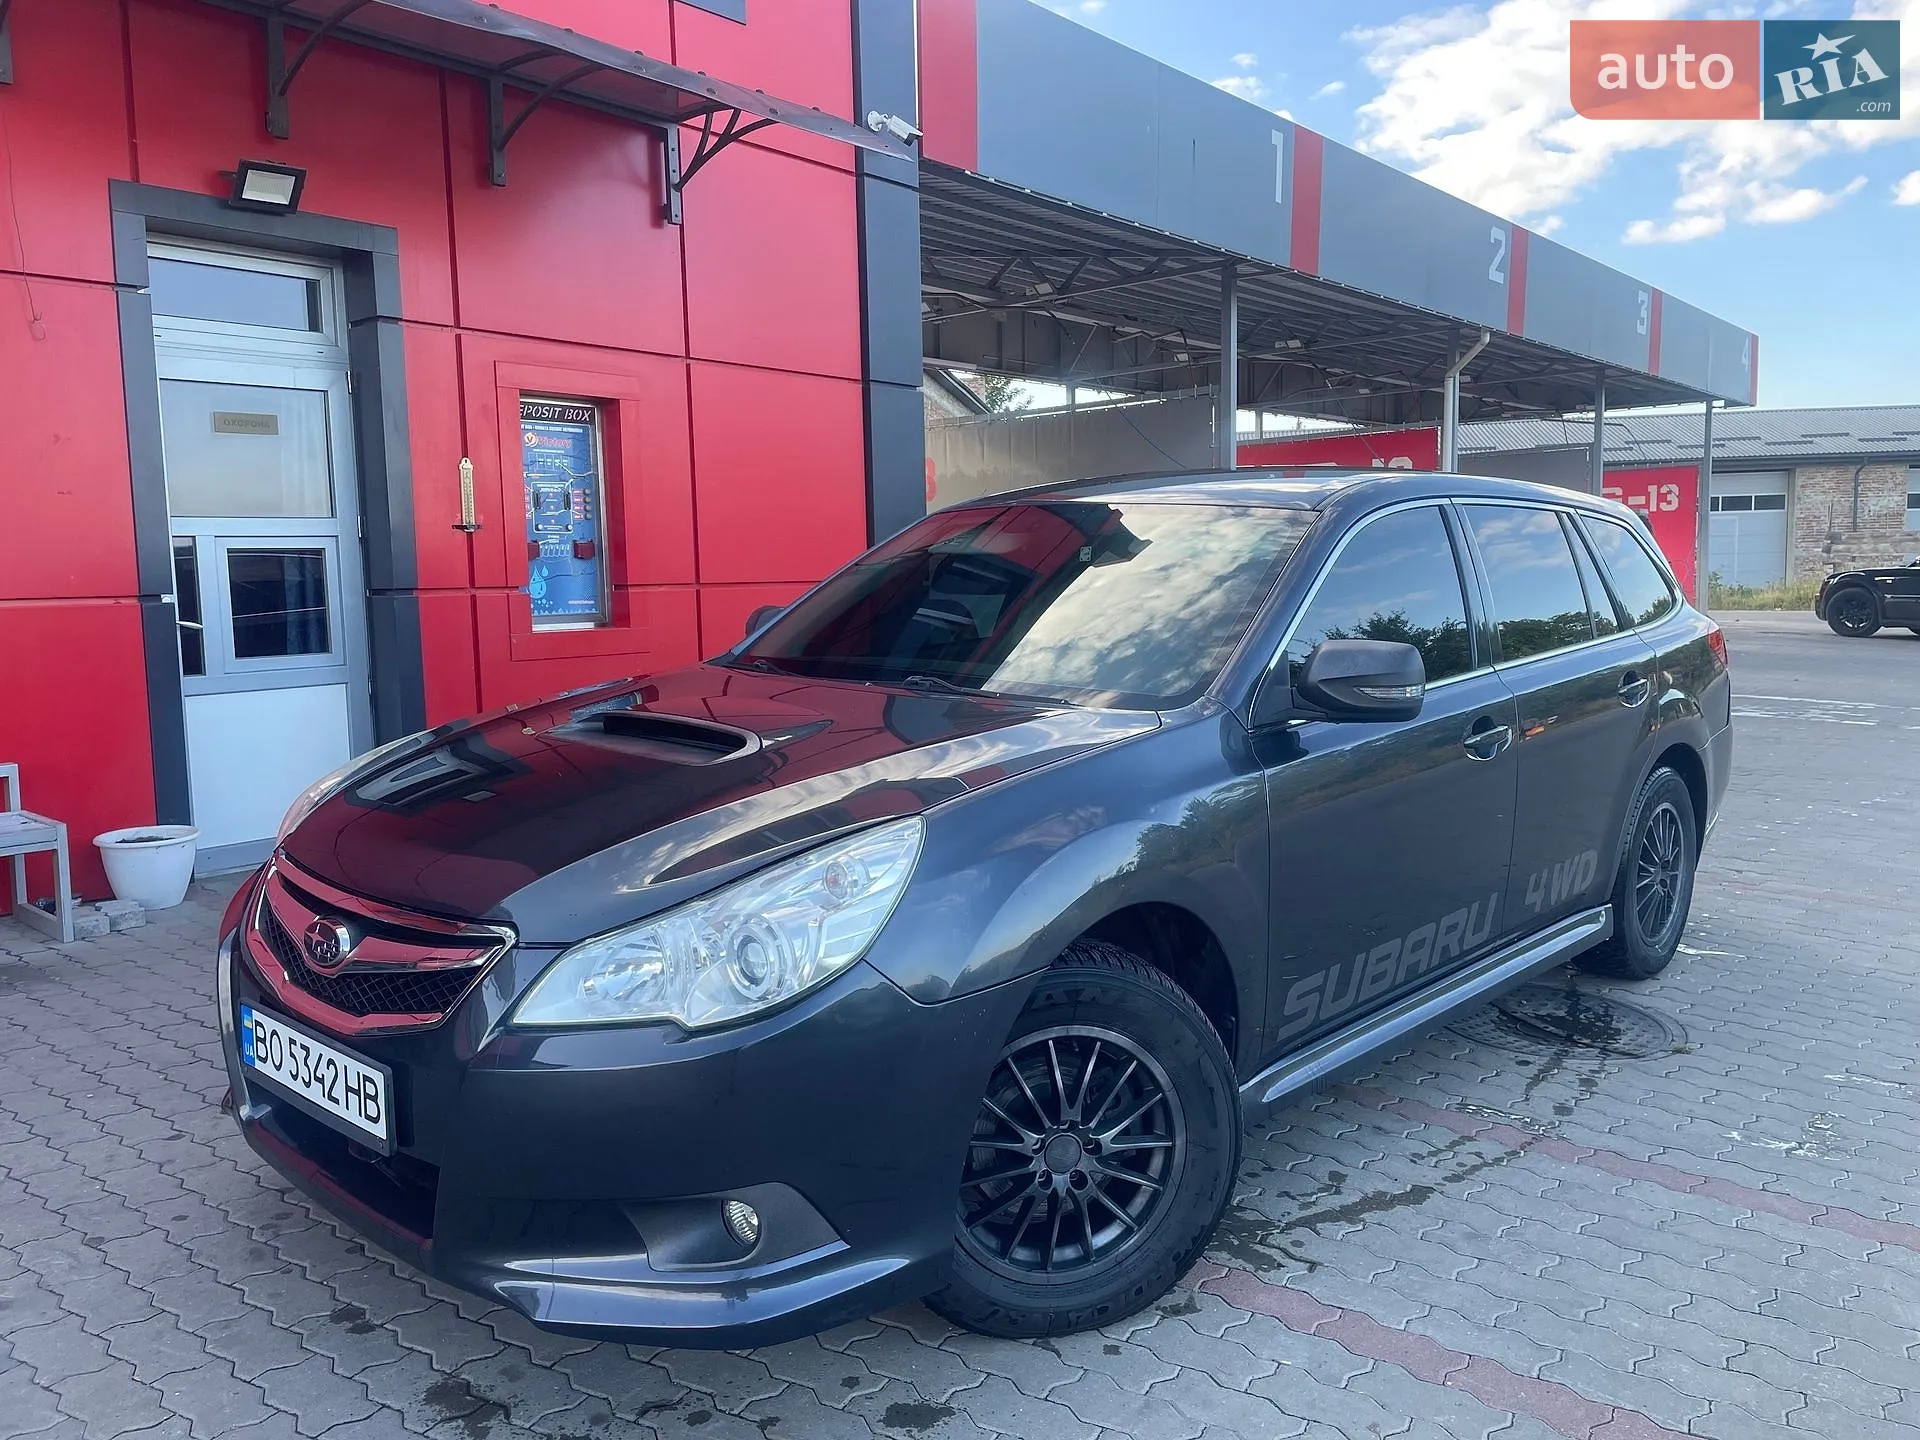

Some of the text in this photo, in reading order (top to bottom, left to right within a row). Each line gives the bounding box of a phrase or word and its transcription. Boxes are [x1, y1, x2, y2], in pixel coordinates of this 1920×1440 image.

[1271, 129, 1284, 204] 1
[1488, 226, 1506, 284] 2
[1637, 289, 1649, 336] 3
[1741, 337, 1749, 373] 4
[564, 408, 592, 421] BOX
[1277, 849, 1598, 1042] SUBARU 4WD
[244, 1043, 255, 1058] UA
[254, 1019, 381, 1125] BO 5342 HB
